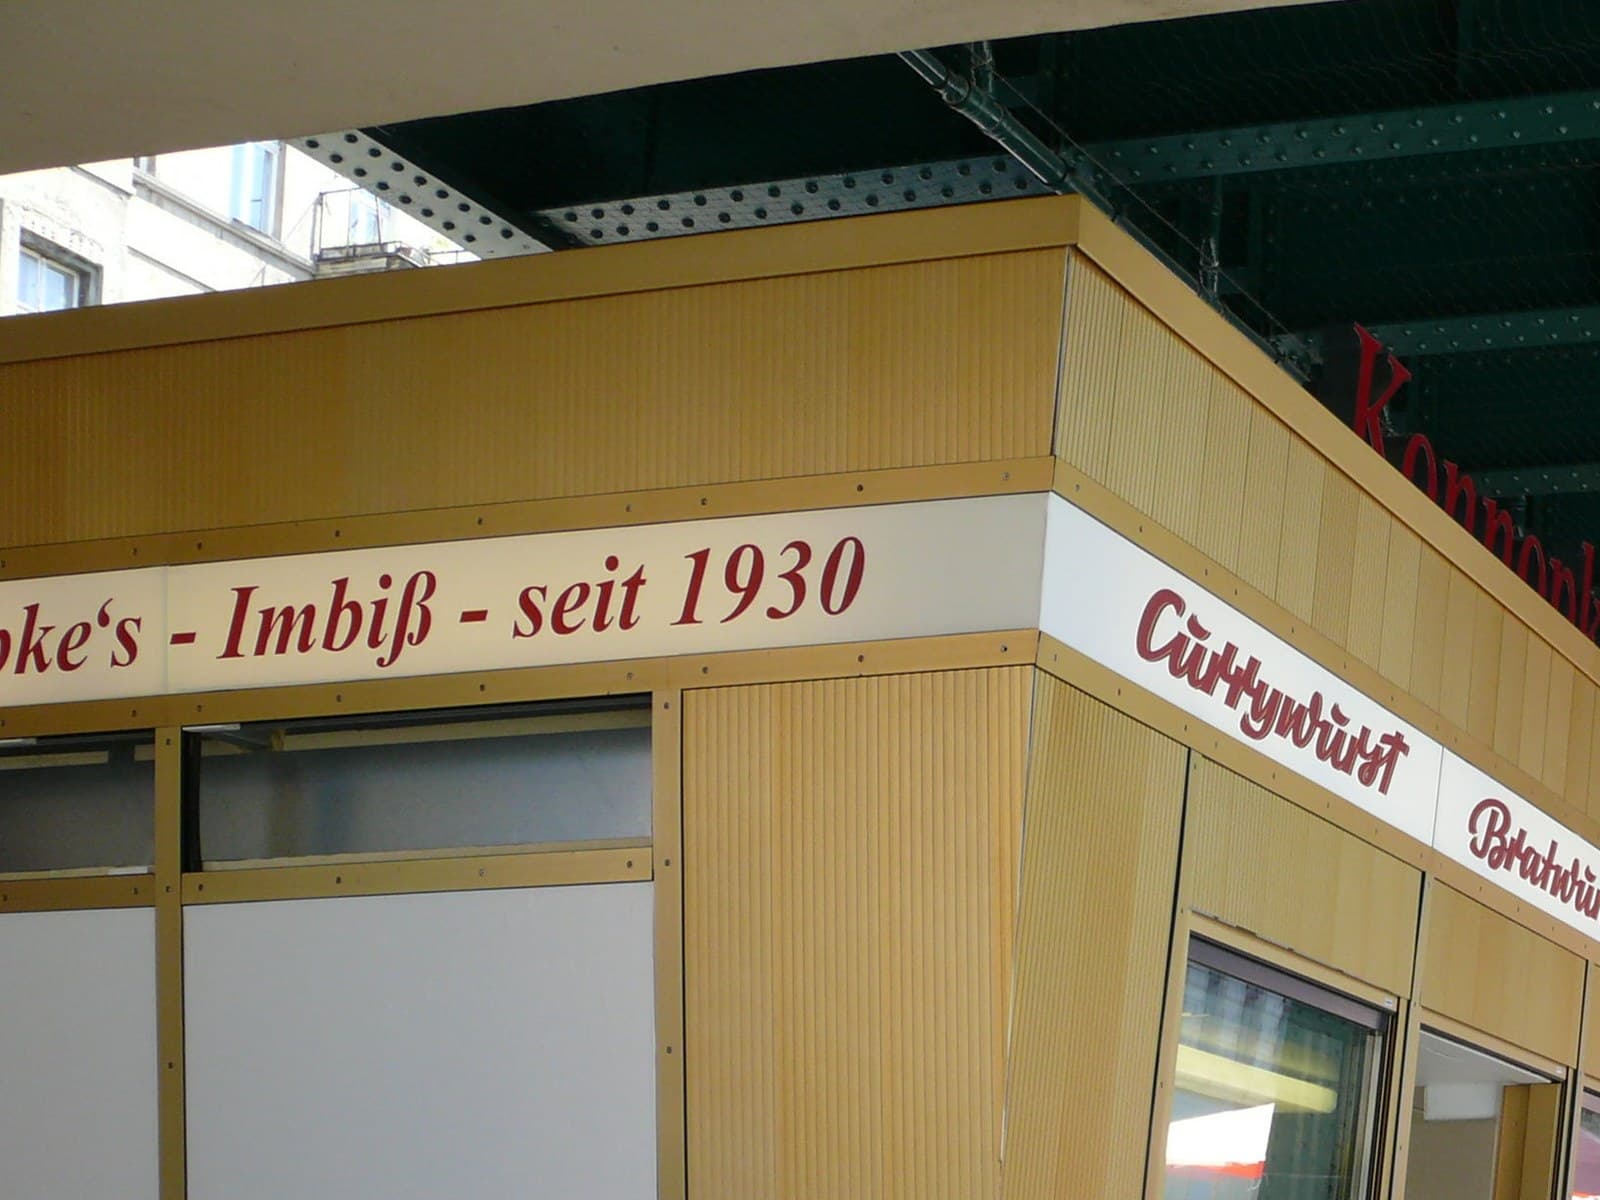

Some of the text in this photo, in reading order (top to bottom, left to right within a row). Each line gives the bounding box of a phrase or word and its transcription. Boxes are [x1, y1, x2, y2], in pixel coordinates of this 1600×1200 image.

[170, 631, 196, 645] -
[216, 570, 437, 667] Imbiß
[459, 609, 488, 622] -
[512, 555, 646, 640] seit
[669, 536, 865, 627] 1930
